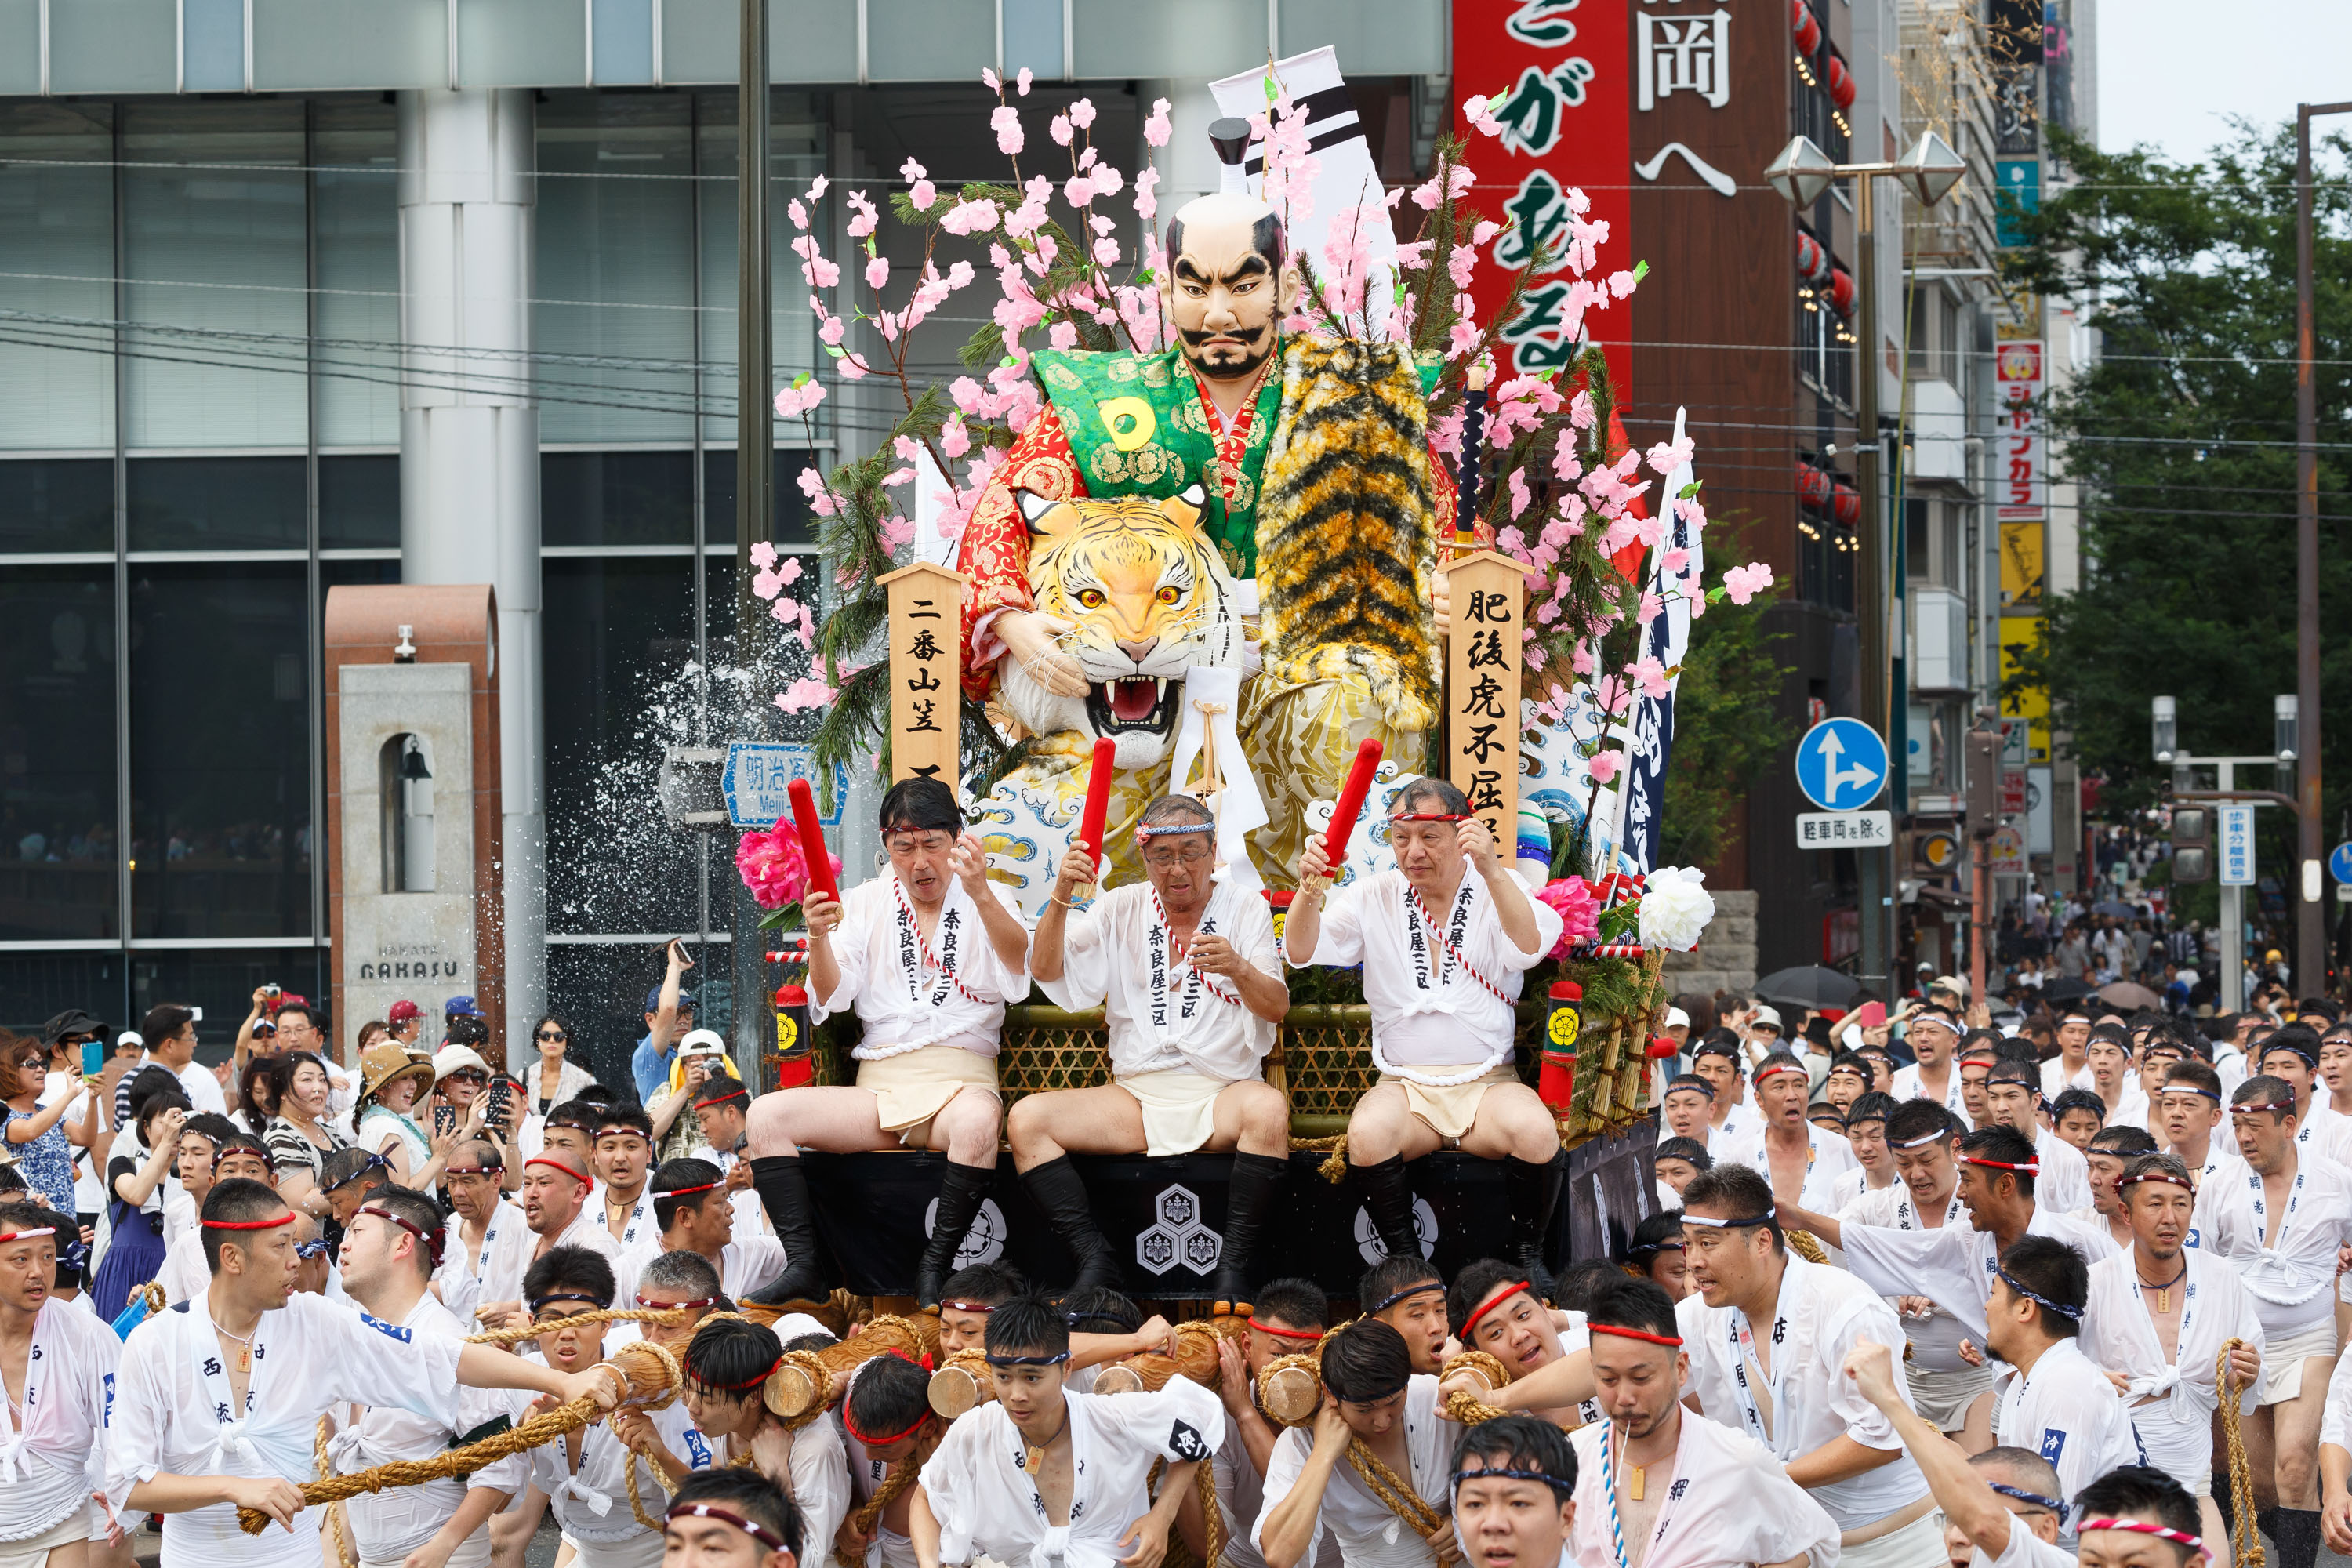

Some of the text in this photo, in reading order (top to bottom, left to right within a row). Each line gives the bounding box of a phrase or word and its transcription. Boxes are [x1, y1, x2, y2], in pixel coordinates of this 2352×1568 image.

[1635, 0, 1737, 197] 岡へ
[2009, 383, 2031, 504] ジャンカラ
[906, 600, 945, 733] 二番山笠
[1461, 590, 1512, 859] 肥後虎不屈
[1804, 819, 1885, 840] 軽車両を除く
[2228, 811, 2245, 880] 歩車分離信号
[361, 961, 457, 979] NAKASU
[932, 908, 961, 1007] 奈良屋三区
[1149, 924, 1167, 1026] 奈良屋三区
[1403, 887, 1430, 989] 奈良屋三区
[203, 1356, 233, 1425] 西流
